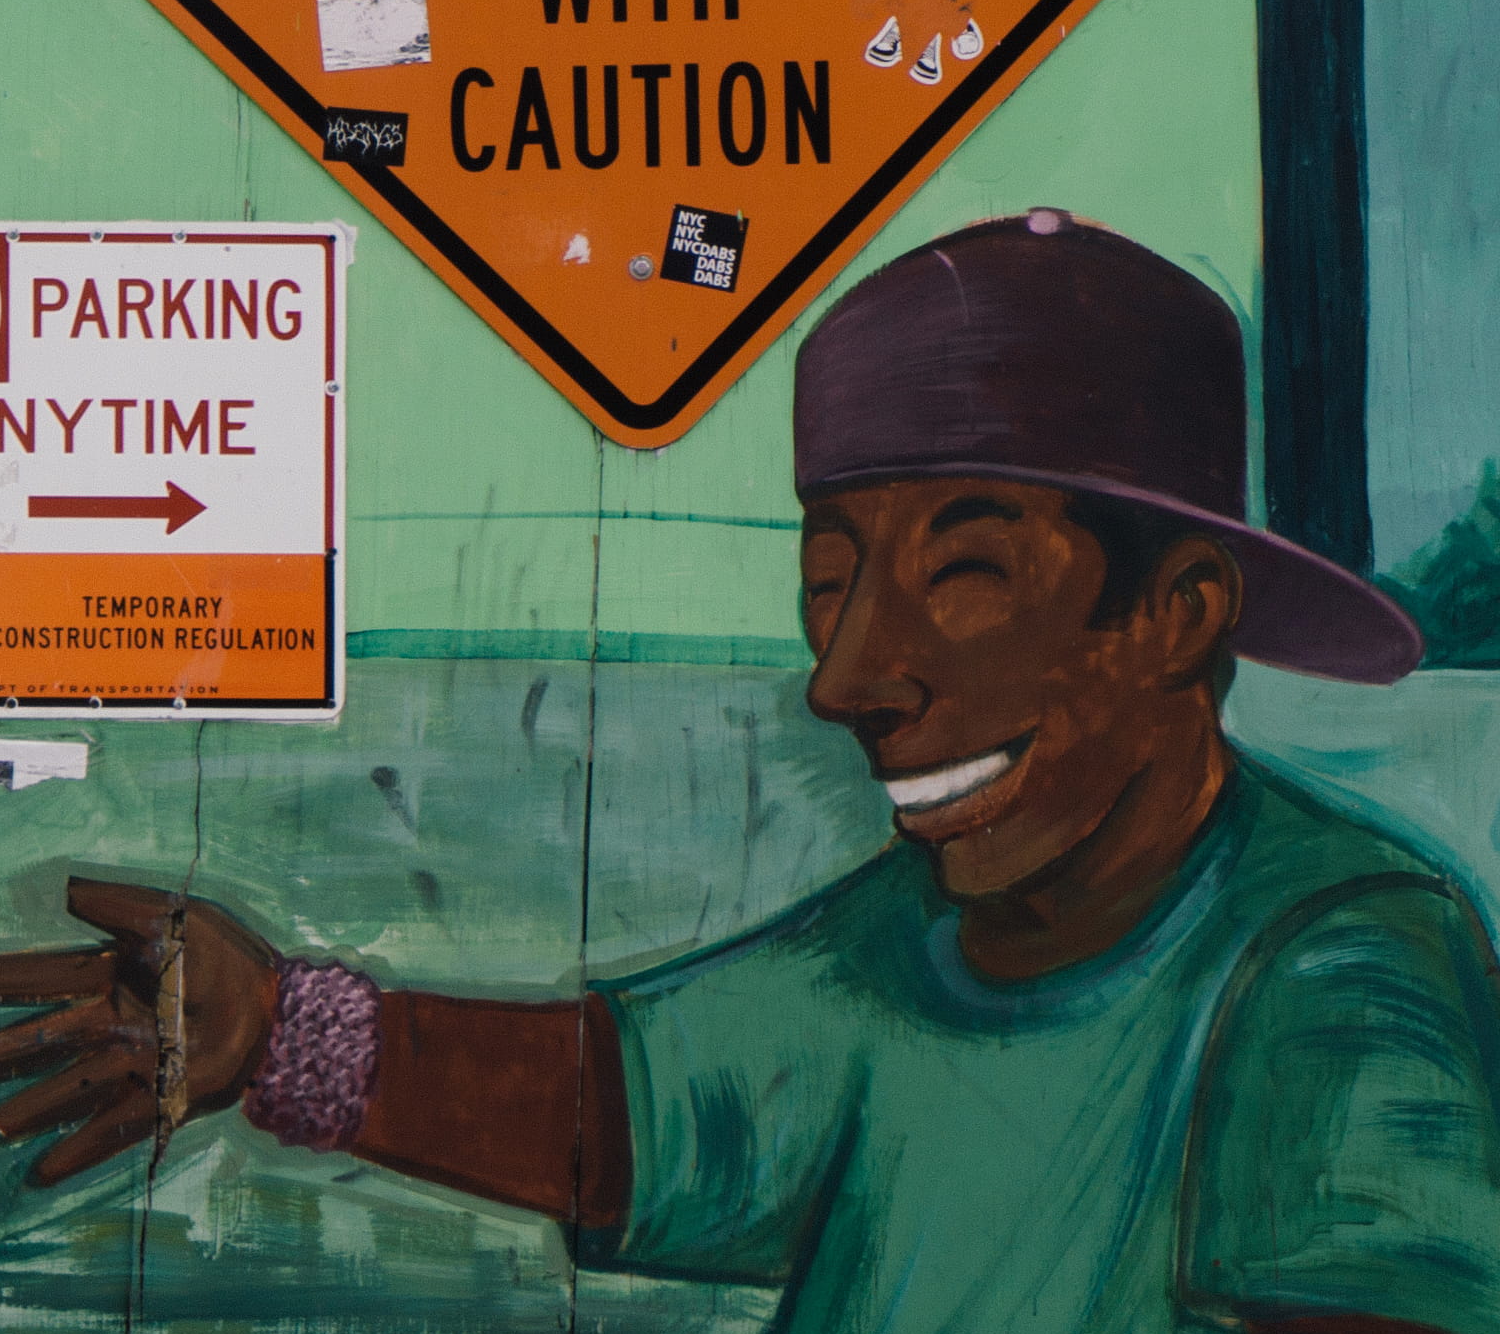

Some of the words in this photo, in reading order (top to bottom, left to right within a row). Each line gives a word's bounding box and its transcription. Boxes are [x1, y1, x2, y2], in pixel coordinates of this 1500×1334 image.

[449, 60, 833, 173] CAUTION
[678, 210, 707, 228] NYC
[675, 224, 704, 241] NYC
[672, 237, 737, 262] NYCDABS
[697, 256, 735, 276] DABS
[693, 269, 732, 289] DABS
[31, 277, 304, 342] PARKING
[81, 595, 224, 620] TEMPORARY
[174, 626, 317, 652] REGULATION
[26, 685, 48, 694] OF
